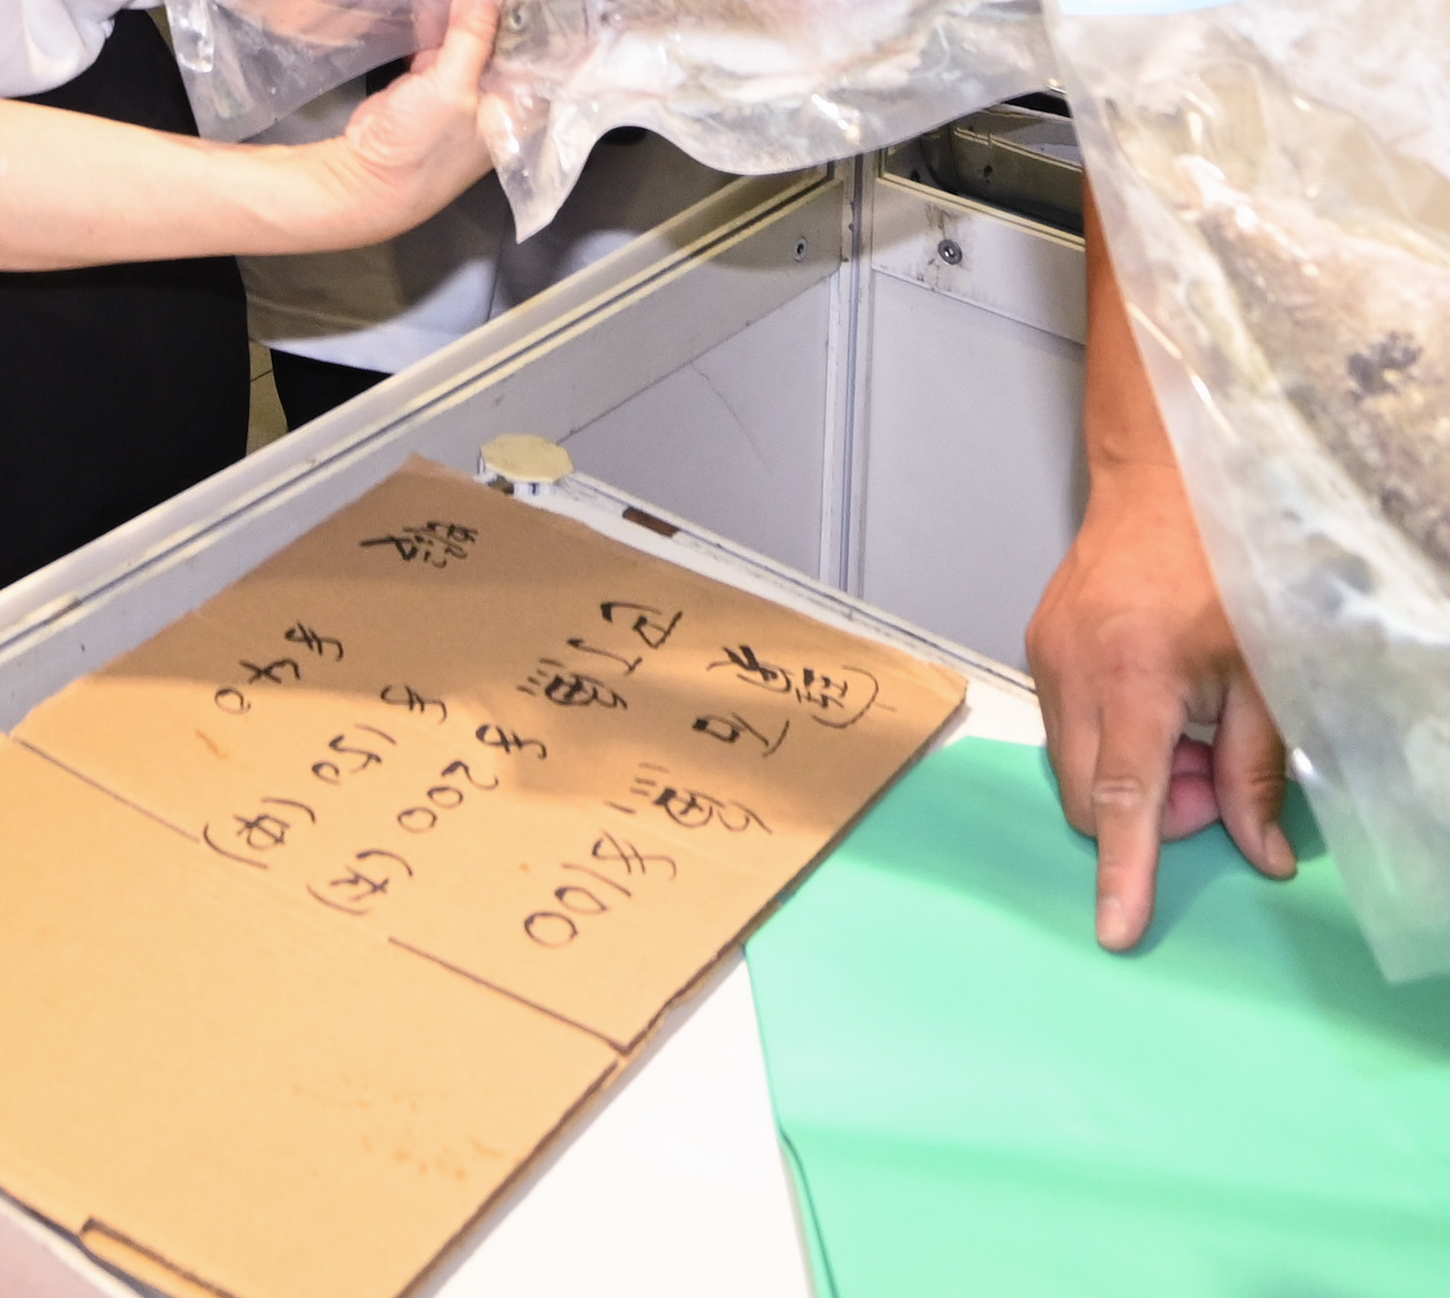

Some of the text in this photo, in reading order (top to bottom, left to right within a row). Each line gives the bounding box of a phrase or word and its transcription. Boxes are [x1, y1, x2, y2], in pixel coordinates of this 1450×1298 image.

[213, 620, 346, 716] $40
[311, 682, 448, 786] $150
[396, 722, 547, 834] $200
[524, 832, 678, 949] $100
